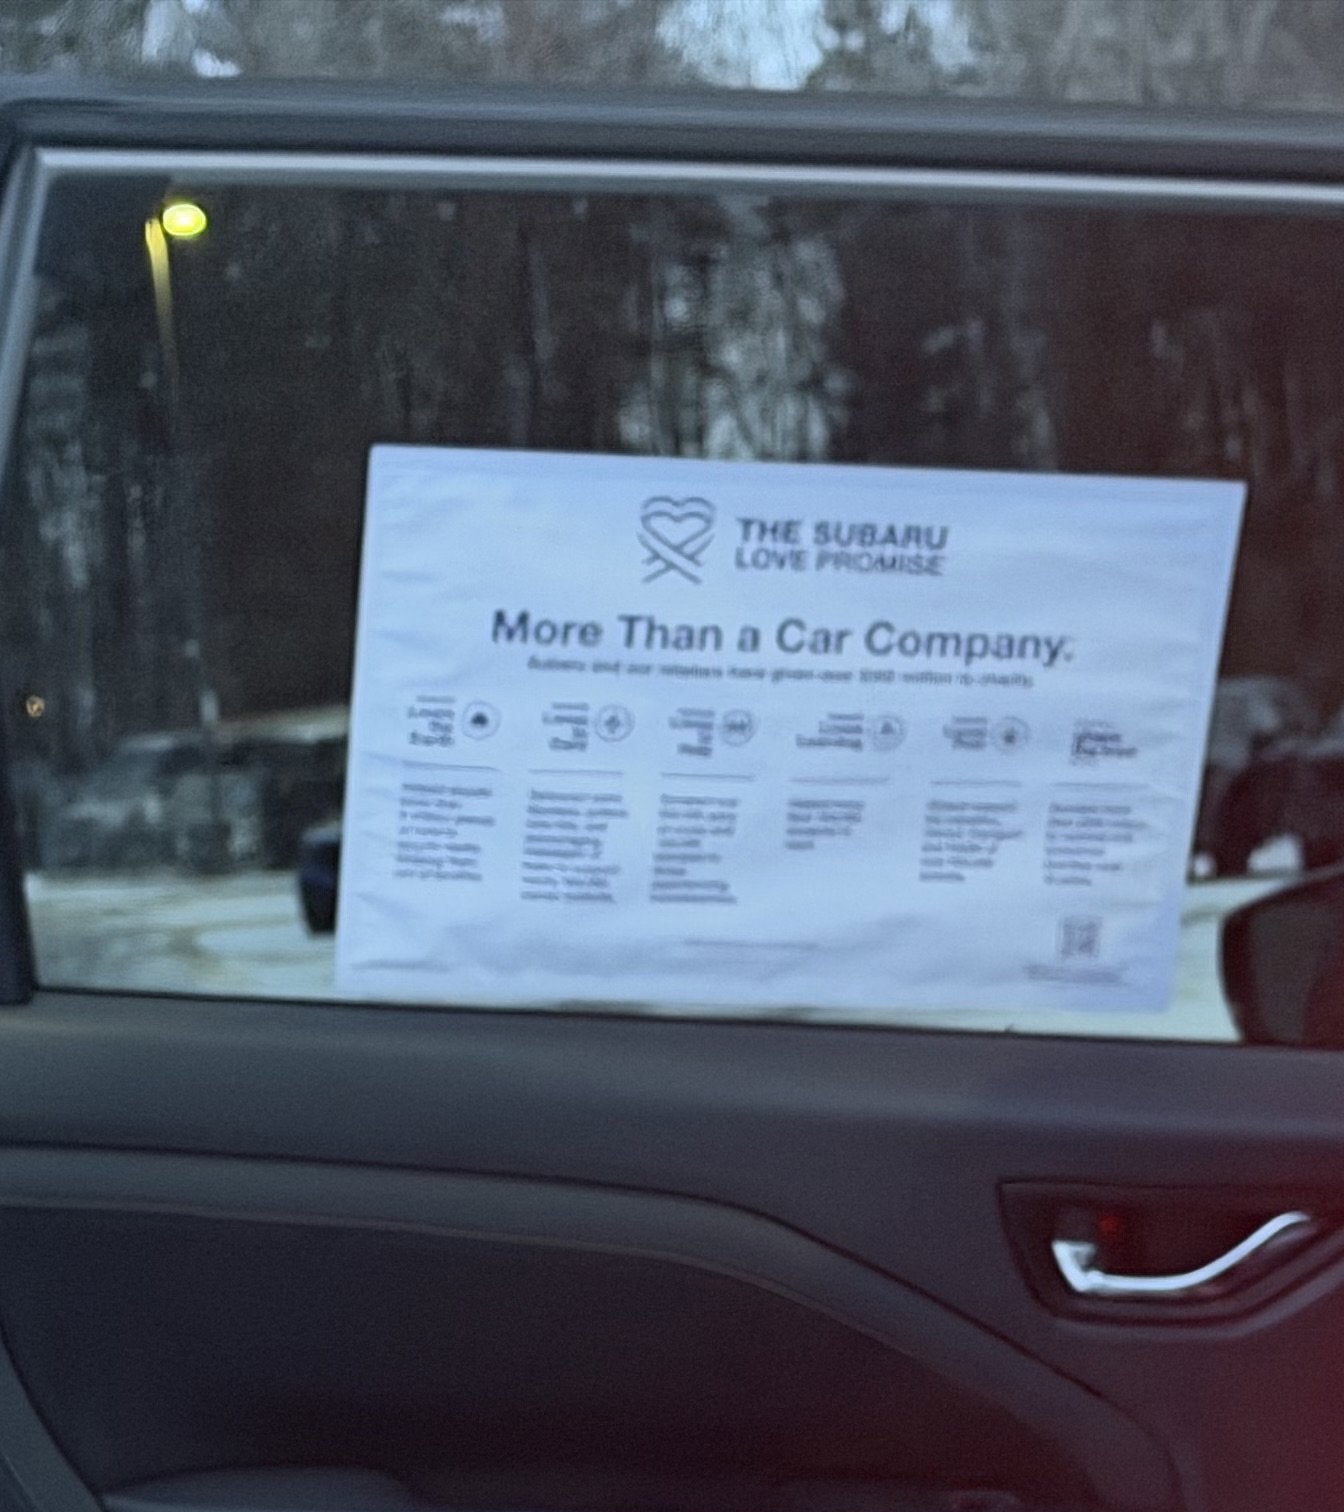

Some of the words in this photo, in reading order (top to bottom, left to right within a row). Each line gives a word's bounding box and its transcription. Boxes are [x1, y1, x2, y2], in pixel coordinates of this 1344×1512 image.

[735, 516, 803, 545] THE
[812, 520, 951, 551] SUBARU
[734, 547, 807, 572] LOVE
[814, 549, 947, 577] PROMISE
[491, 608, 603, 646] More
[617, 613, 723, 651] Than
[737, 625, 761, 652] a
[775, 617, 853, 654] Car
[864, 620, 1075, 669] Company.
